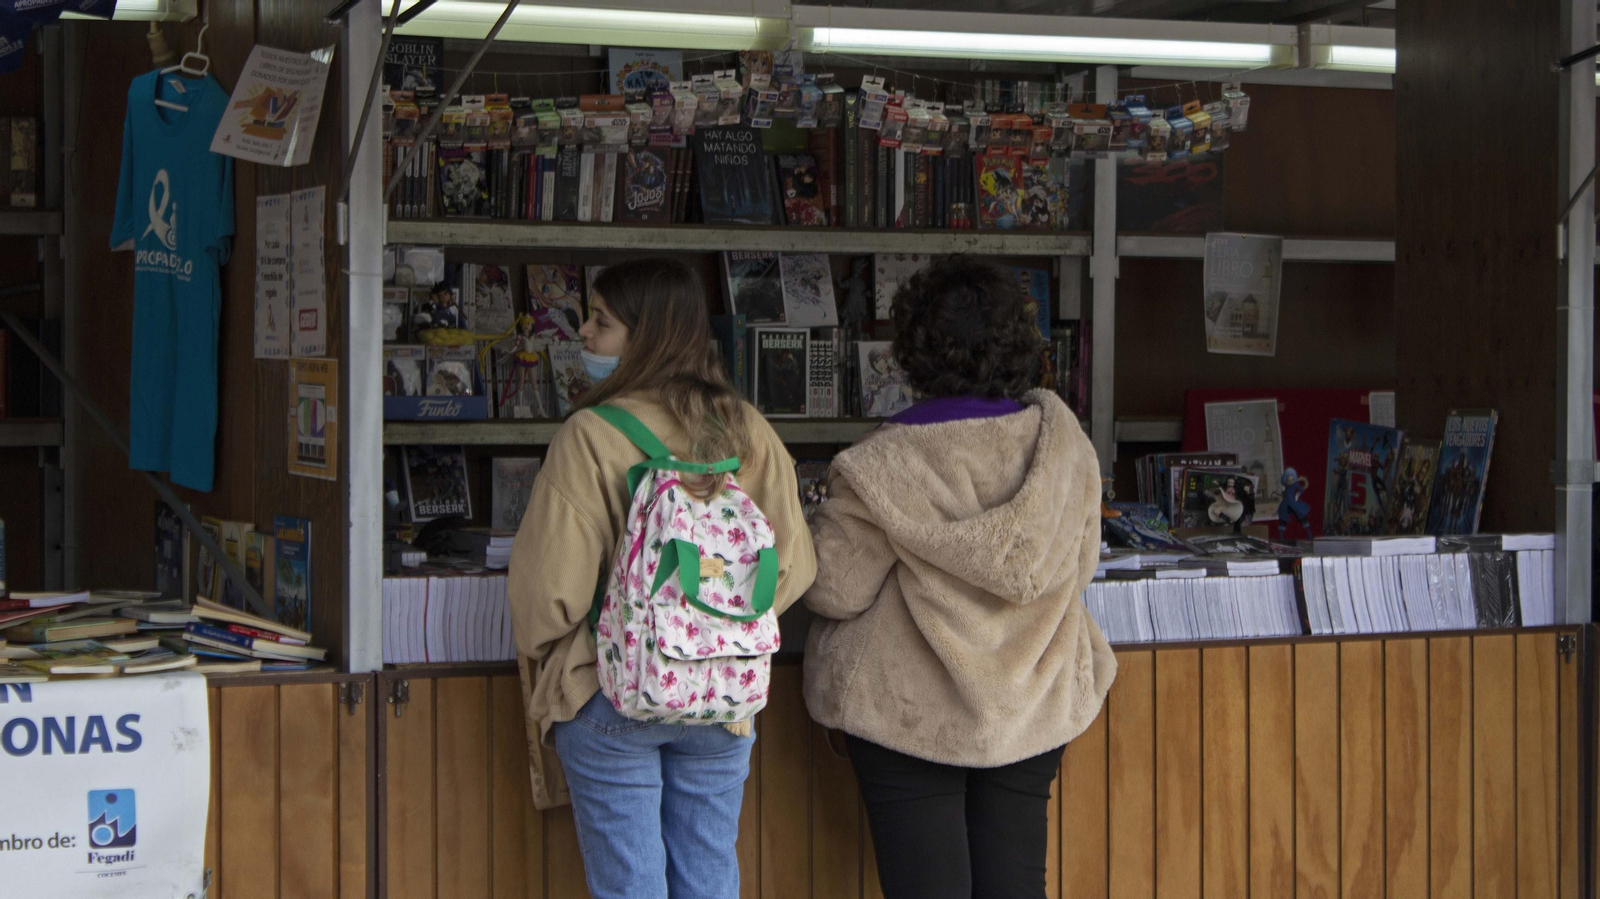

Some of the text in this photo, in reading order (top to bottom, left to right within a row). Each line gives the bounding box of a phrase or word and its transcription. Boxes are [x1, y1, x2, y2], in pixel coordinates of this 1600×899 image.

[388, 43, 434, 55] GOBLIN
[385, 54, 437, 66] SLAYER
[704, 130, 753, 142] HAY ALGO
[703, 142, 757, 154] MATANDO
[714, 154, 749, 166] NIÑOS
[731, 251, 774, 261] BERSERK
[1212, 246, 1240, 260] FERIA
[1210, 260, 1253, 278] LIBRO
[762, 339, 804, 349] BERSERK
[809, 343, 818, 396] PARASYTE 6
[817, 343, 825, 396] PARASYTE 7
[825, 343, 833, 387] PARASYTE
[417, 399, 463, 418] Funko
[1448, 416, 1489, 432] LOS NUEVOS
[1213, 427, 1256, 447] LIBRO
[1445, 432, 1486, 448] VENGADORES
[1349, 451, 1372, 468] MARVEL
[1350, 472, 1367, 506] 5
[418, 504, 465, 515] BERSERK
[47, 832, 76, 849] de:
[87, 850, 135, 865] Fegadi
